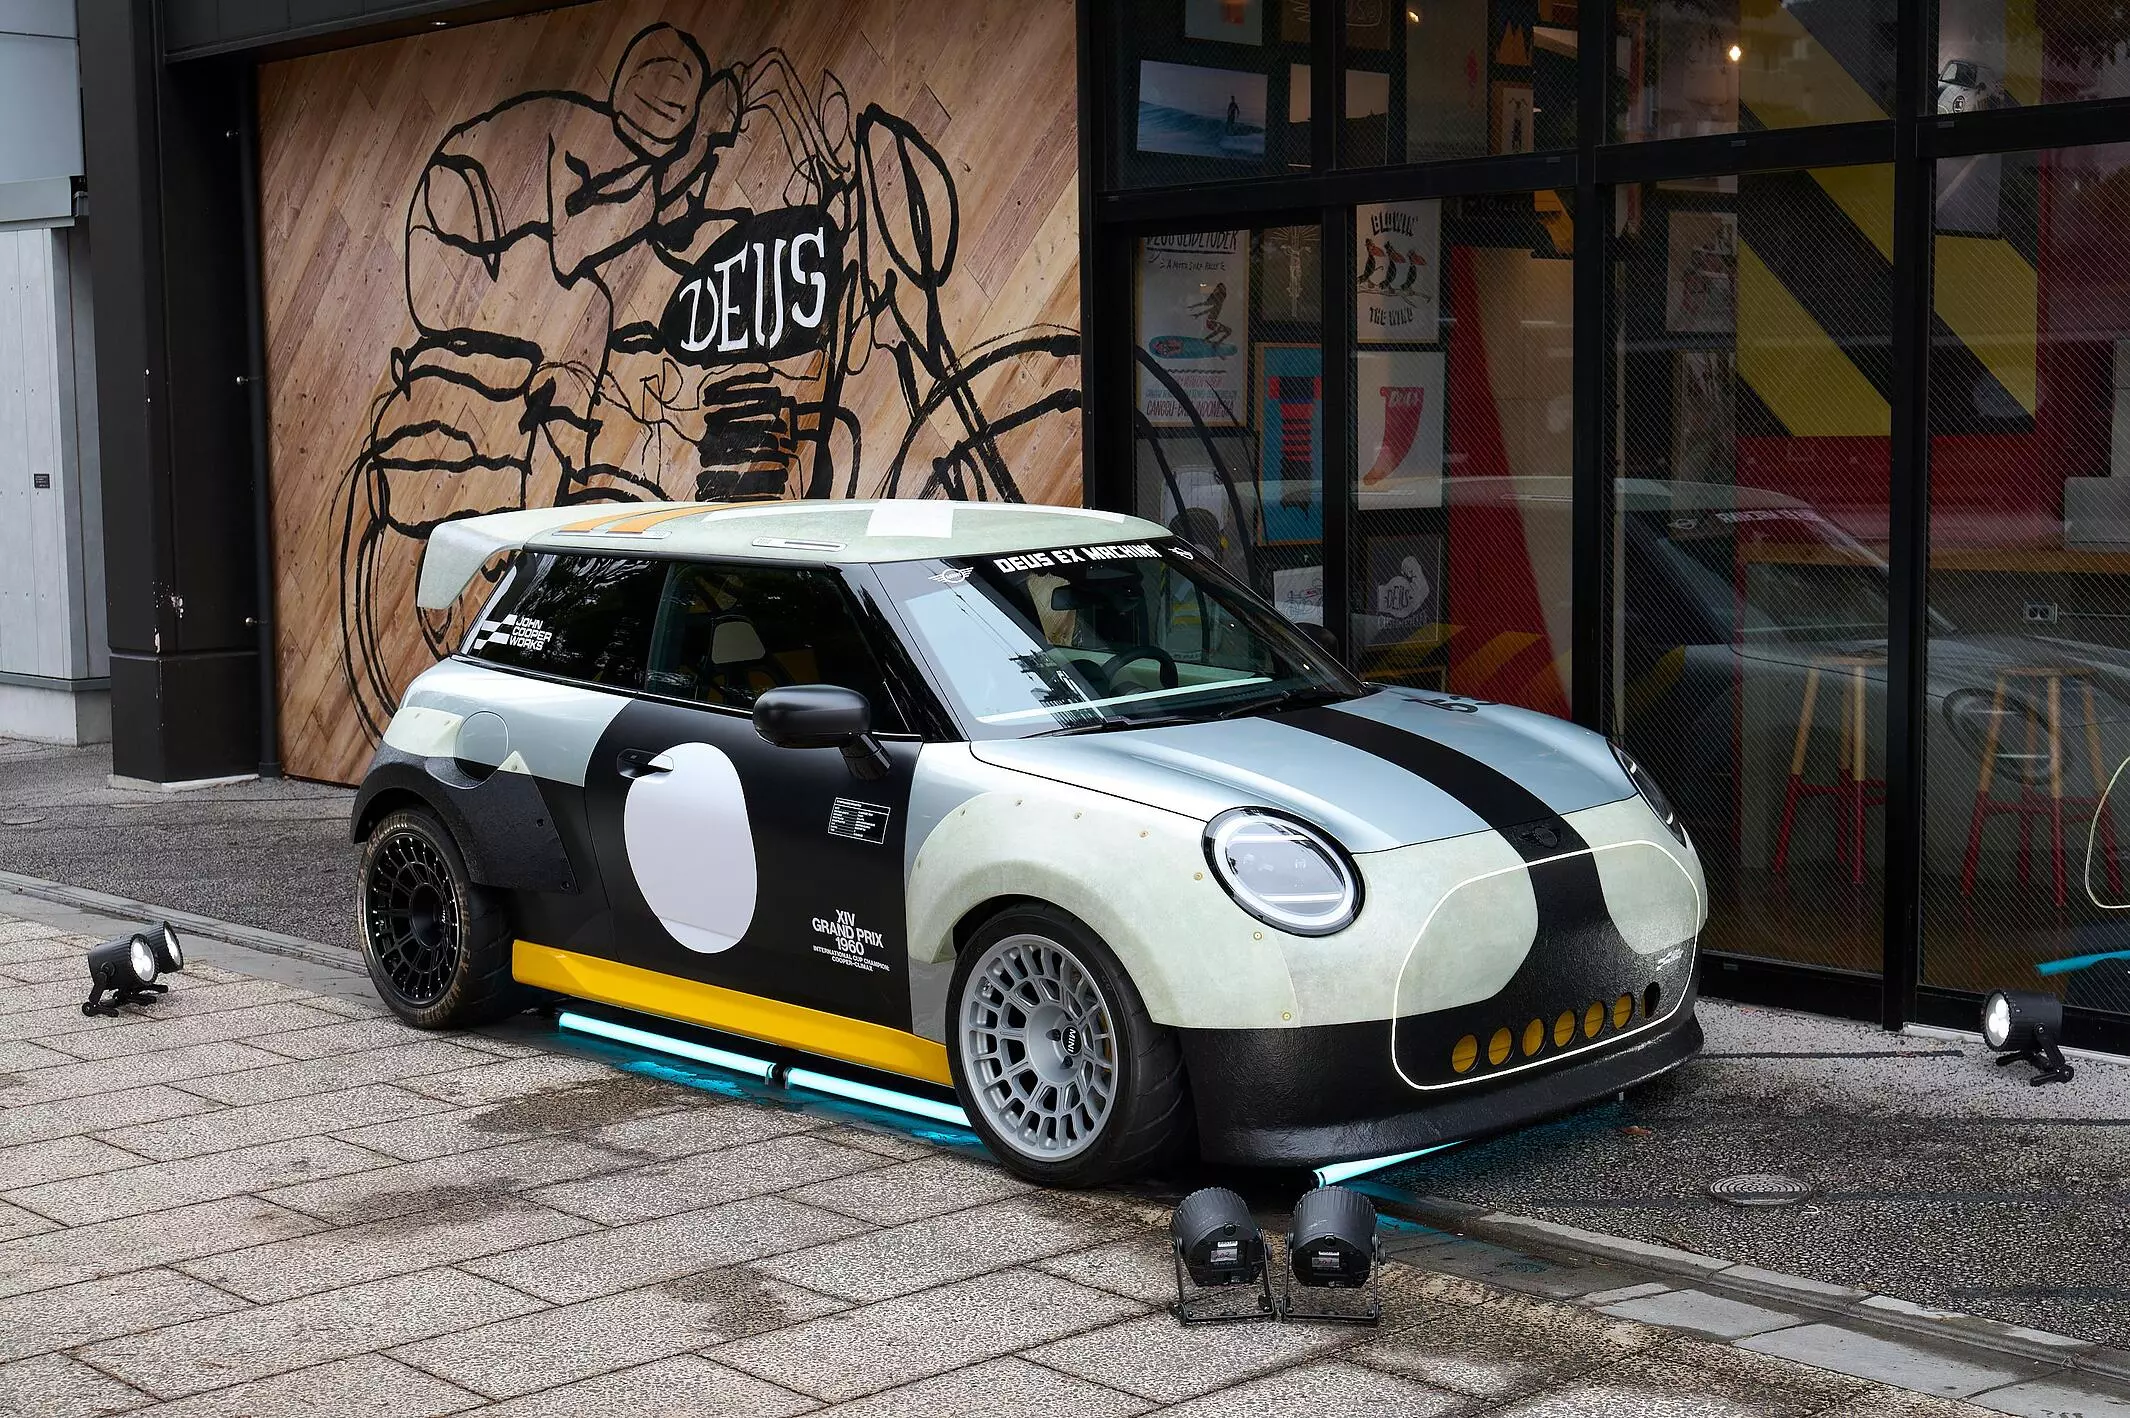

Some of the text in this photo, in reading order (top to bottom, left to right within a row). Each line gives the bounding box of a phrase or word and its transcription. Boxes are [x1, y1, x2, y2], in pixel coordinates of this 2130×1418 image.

[679, 226, 826, 352] DEUS
[1370, 307, 1386, 326] THE
[993, 552, 1051, 574] DEUS
[1054, 547, 1083, 564] EX
[1084, 542, 1163, 562] MACHINA
[515, 615, 544, 630] JOHN
[509, 635, 544, 651] WORKS
[512, 626, 553, 643] COOPER
[835, 909, 856, 927] XIV
[812, 917, 885, 949] GRAND PRIX
[812, 944, 853, 961] INTERNATIONAL
[852, 955, 864, 963] CUP
[835, 936, 865, 956] 1960
[831, 955, 874, 972] COOPER-CLIMAX
[1067, 1028, 1077, 1053] MINI
